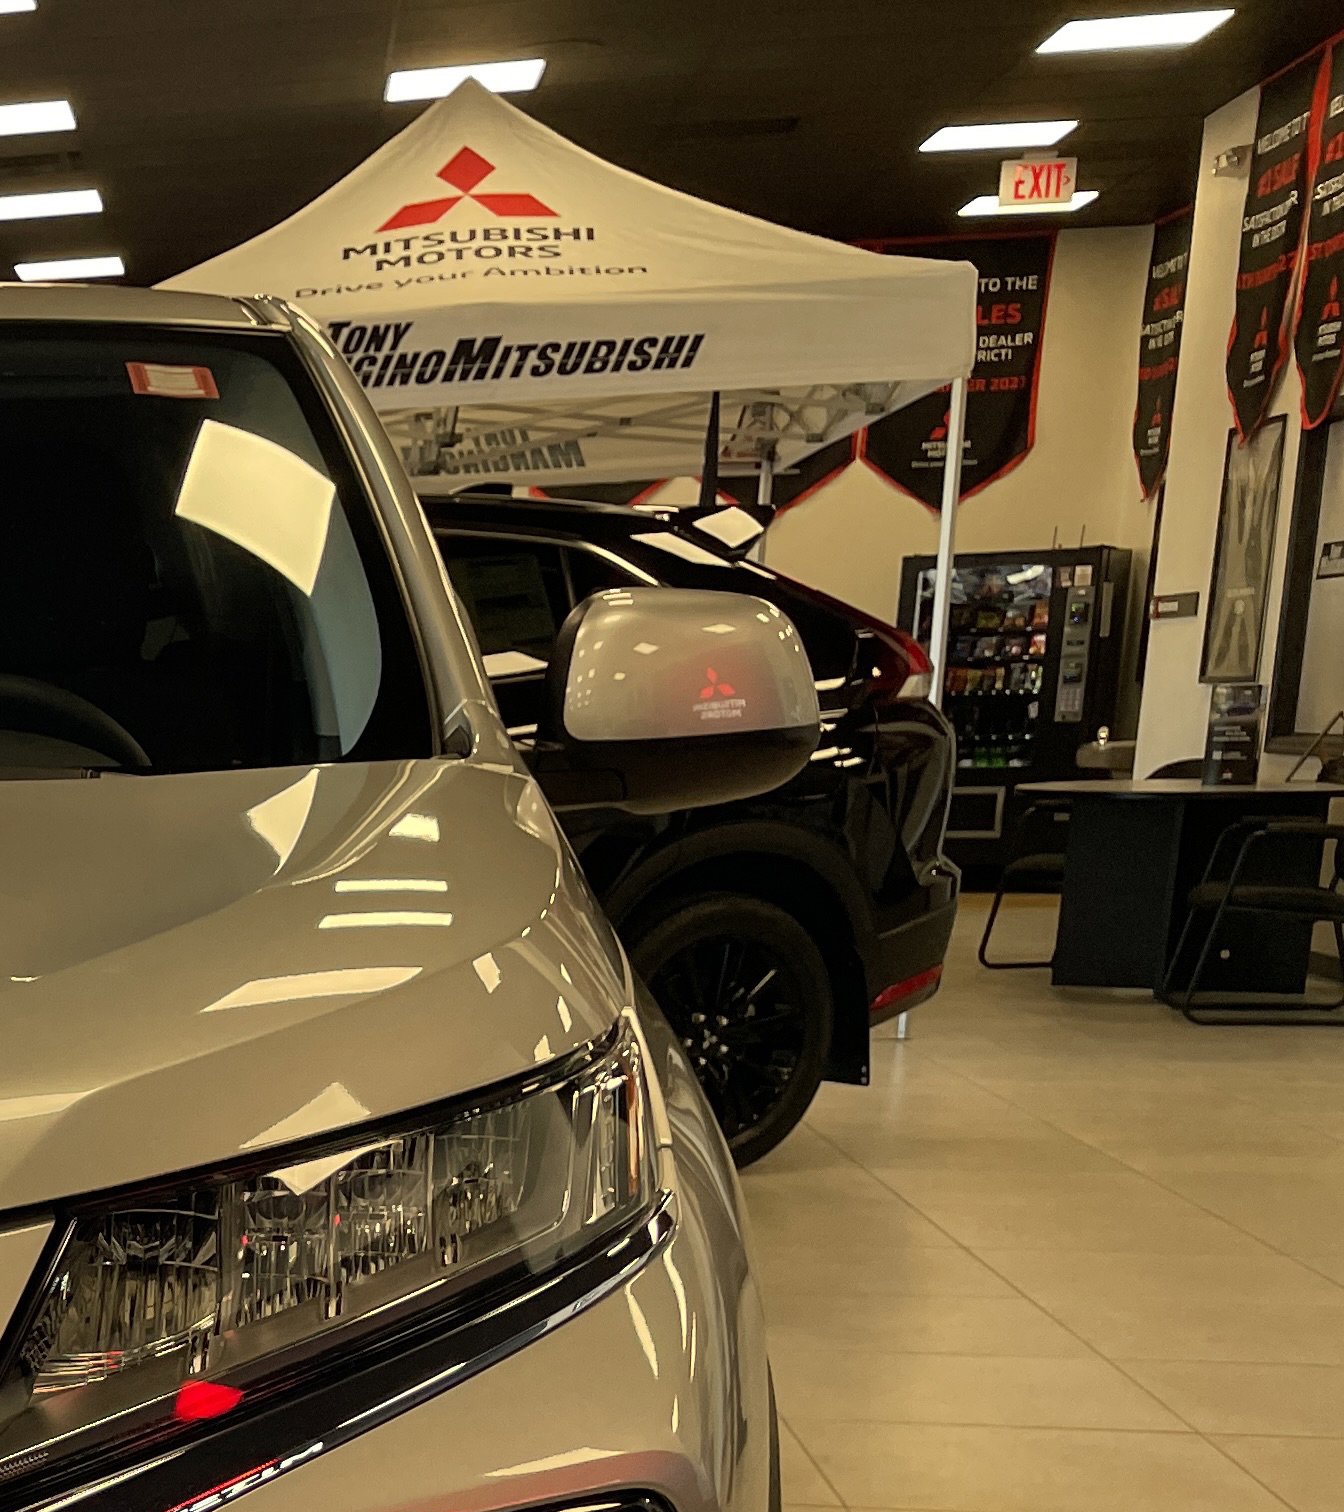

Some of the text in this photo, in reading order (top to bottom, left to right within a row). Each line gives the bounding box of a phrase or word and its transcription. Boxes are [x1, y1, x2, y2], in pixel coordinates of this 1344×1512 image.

[1013, 162, 1066, 200] EXIT
[342, 226, 595, 261] MITSUBISHI
[374, 244, 562, 272] MOTORS
[295, 264, 648, 300] Drive your Ambition
[978, 274, 1039, 293] TO THE
[976, 303, 1022, 326] LES
[327, 320, 414, 355] TONY
[978, 331, 1034, 349] DEALER
